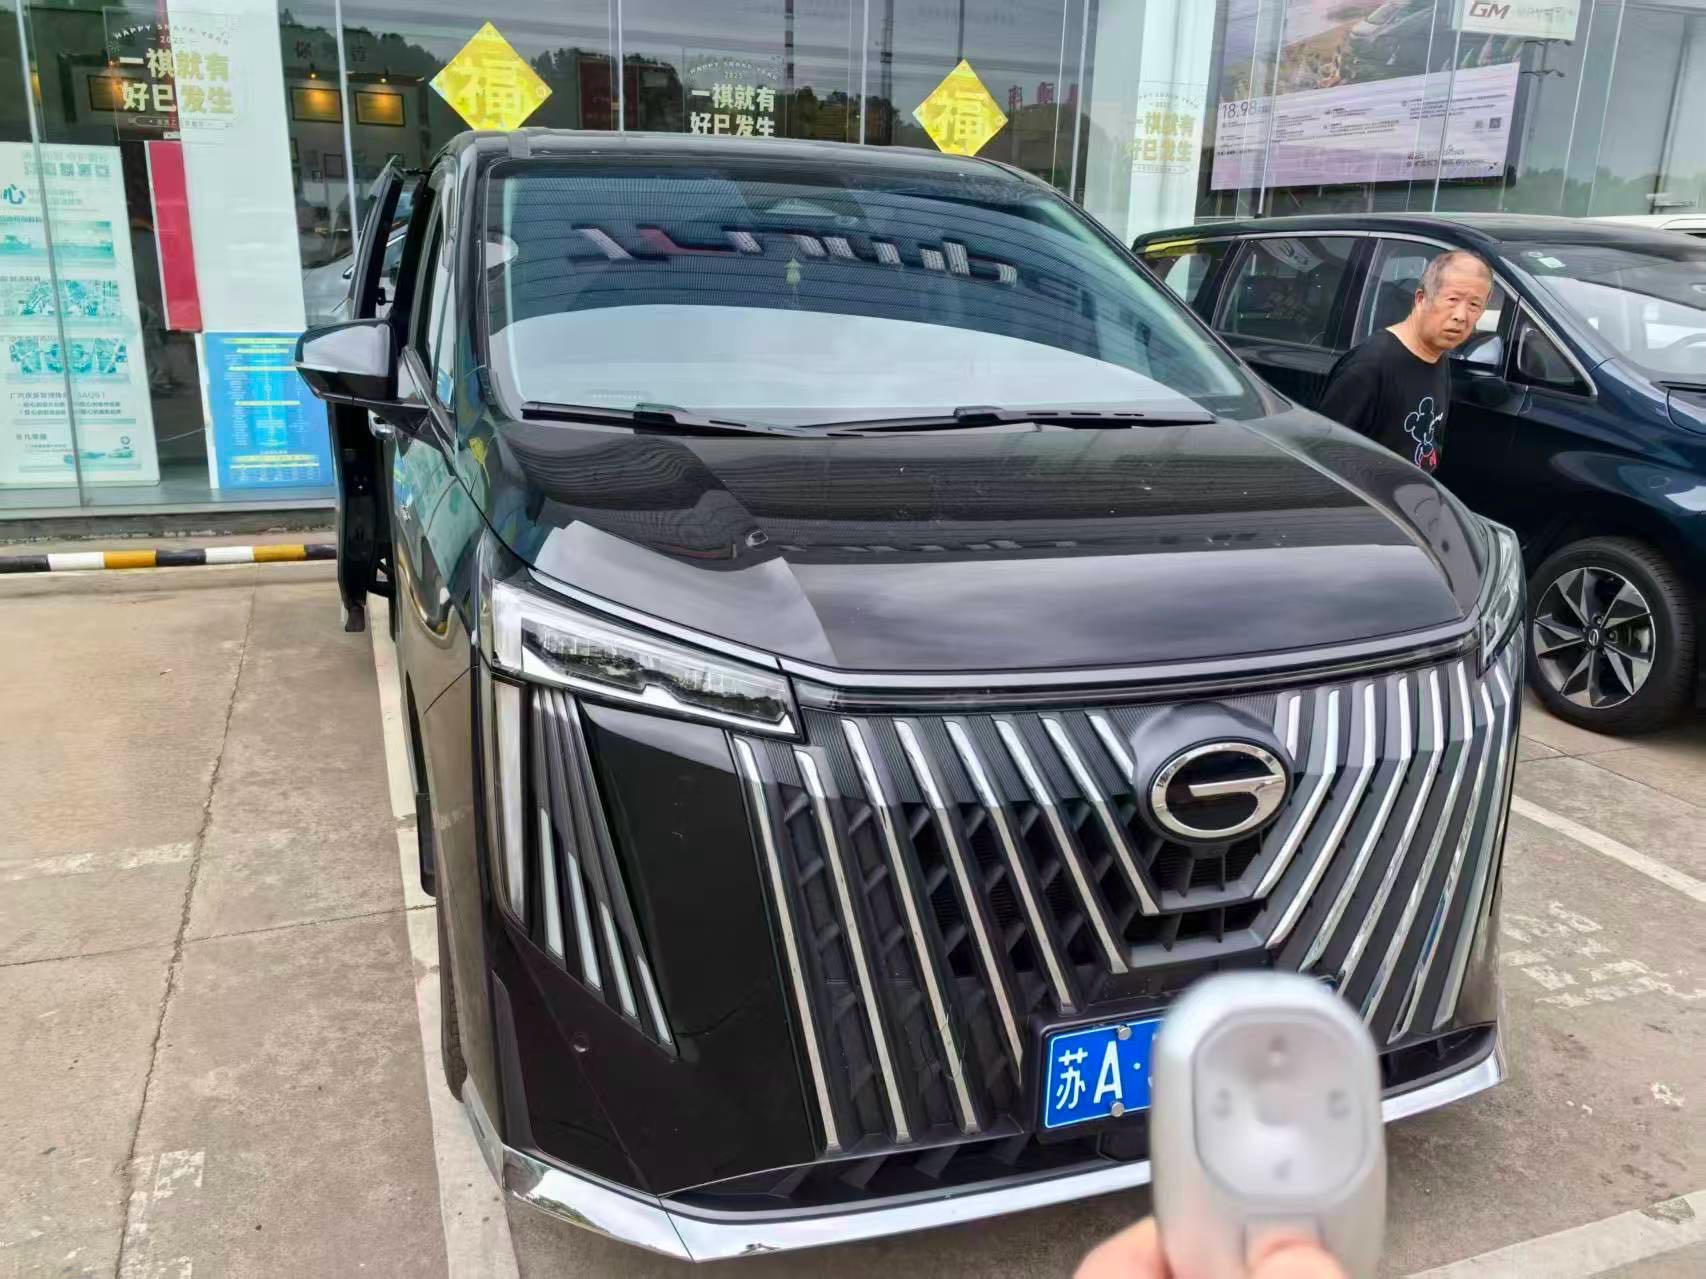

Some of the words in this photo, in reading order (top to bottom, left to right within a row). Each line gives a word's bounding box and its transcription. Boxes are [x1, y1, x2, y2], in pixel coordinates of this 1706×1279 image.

[691, 82, 776, 113] 一祺就有
[1222, 101, 1257, 119] 18.98
